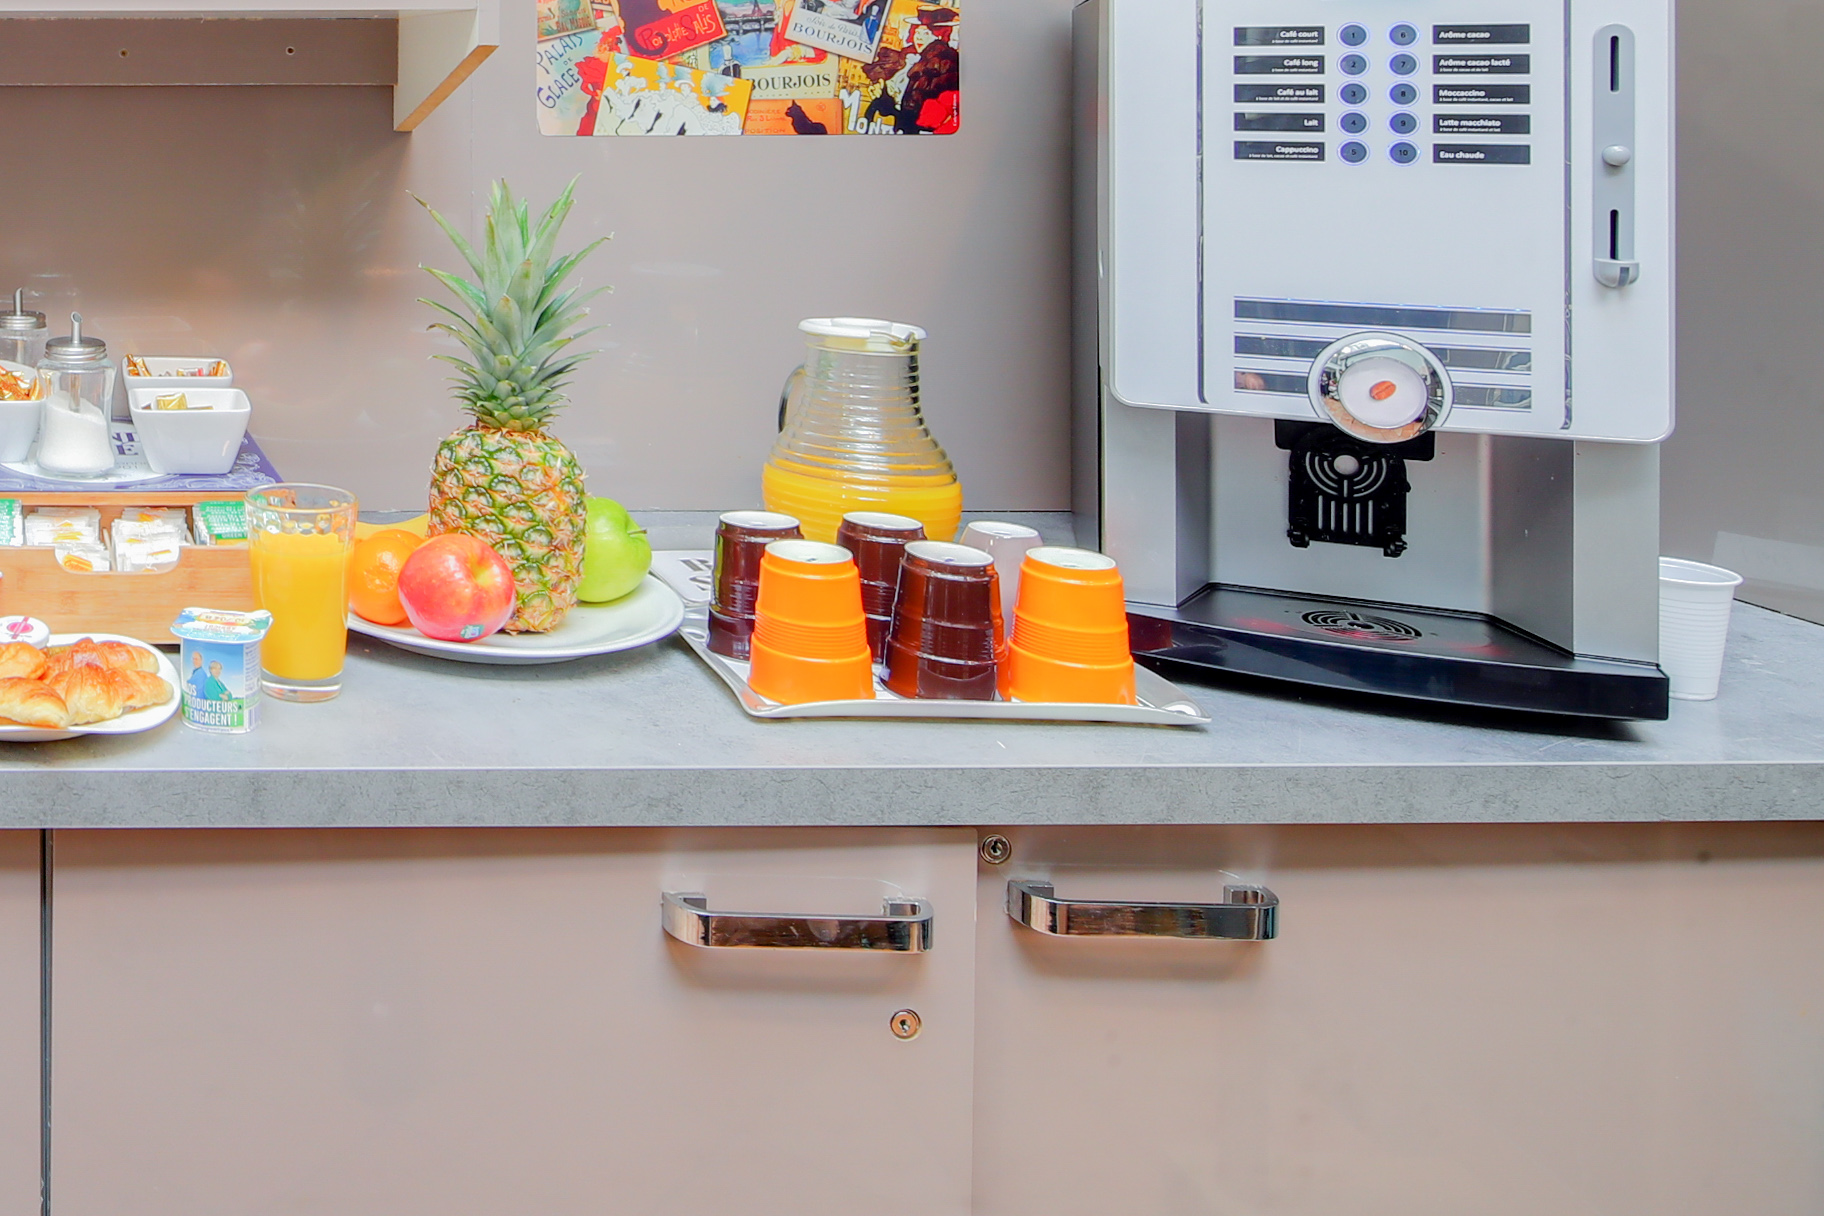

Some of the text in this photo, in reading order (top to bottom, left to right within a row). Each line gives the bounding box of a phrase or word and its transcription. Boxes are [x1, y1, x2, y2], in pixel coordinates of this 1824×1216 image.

[698, 5, 709, 13] DE
[793, 22, 873, 54] BOURJOIS
[1280, 30, 1297, 38] Café
[537, 33, 583, 74] PALAIS
[1302, 59, 1319, 67] long
[537, 68, 580, 109] GLACE
[1439, 119, 1459, 127] Latte
[1275, 146, 1319, 154] Cappuccino
[1456, 151, 1485, 159] chaude
